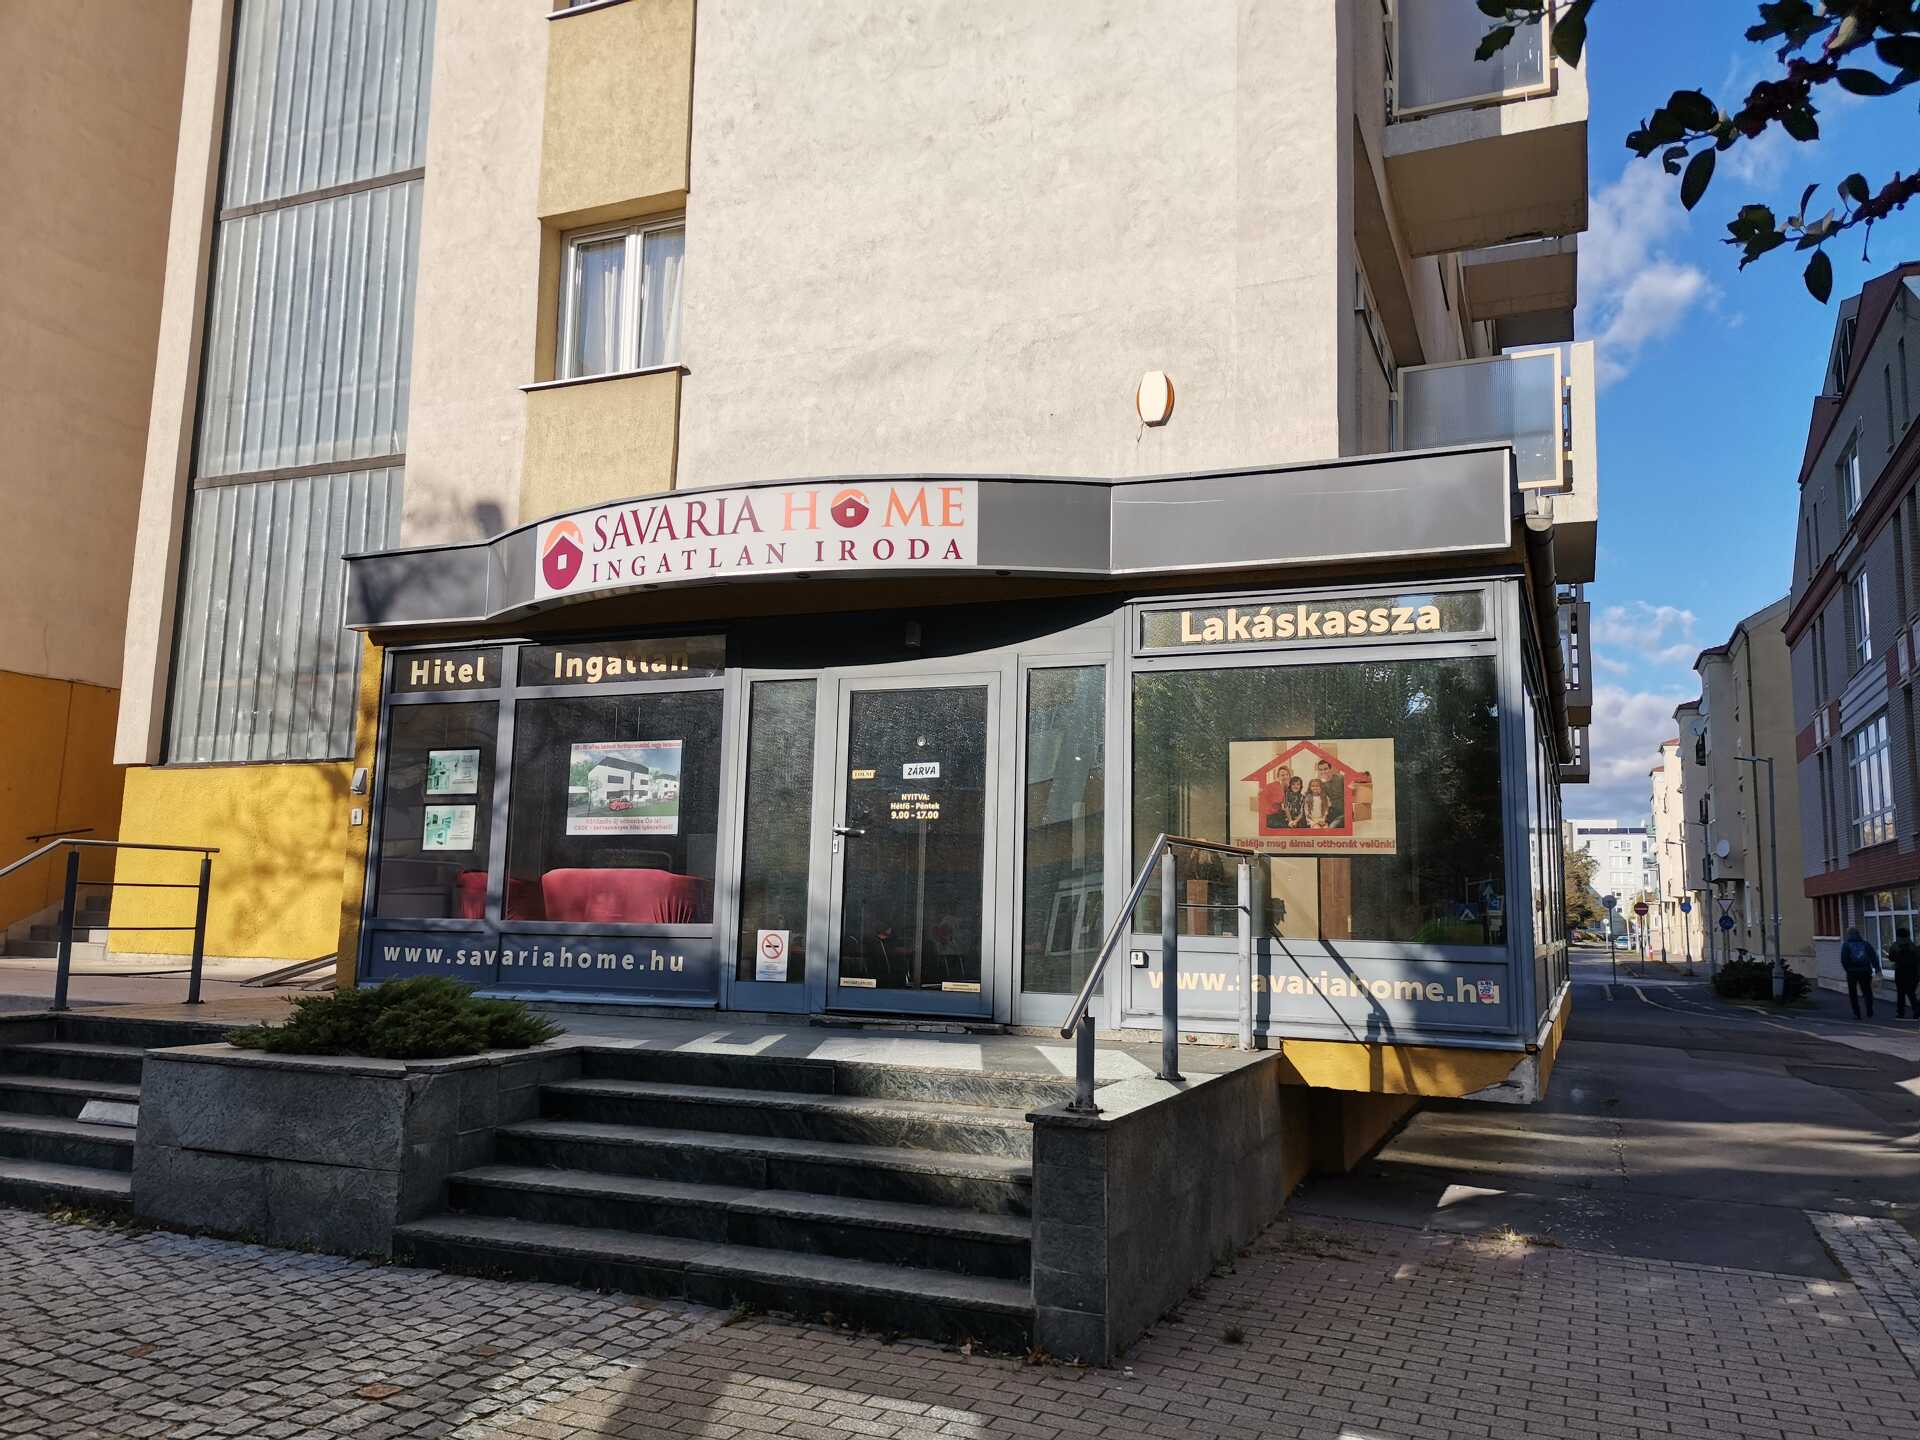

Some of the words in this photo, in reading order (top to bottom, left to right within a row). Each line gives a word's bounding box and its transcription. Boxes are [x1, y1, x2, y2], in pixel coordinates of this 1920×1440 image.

[592, 495, 764, 552] SAVARIA
[783, 486, 964, 531] HOME
[592, 542, 786, 583] INGATLAN
[815, 538, 964, 561] IRODA
[1181, 604, 1440, 643] Lakáskassza
[411, 656, 485, 685] Hitel
[907, 765, 936, 776] ZÁRVA
[891, 811, 909, 819] 9.00
[916, 811, 939, 819] 17.00
[383, 945, 684, 972] www.savariahome.hu
[1148, 969, 1500, 1004] www.avariahome.hu
